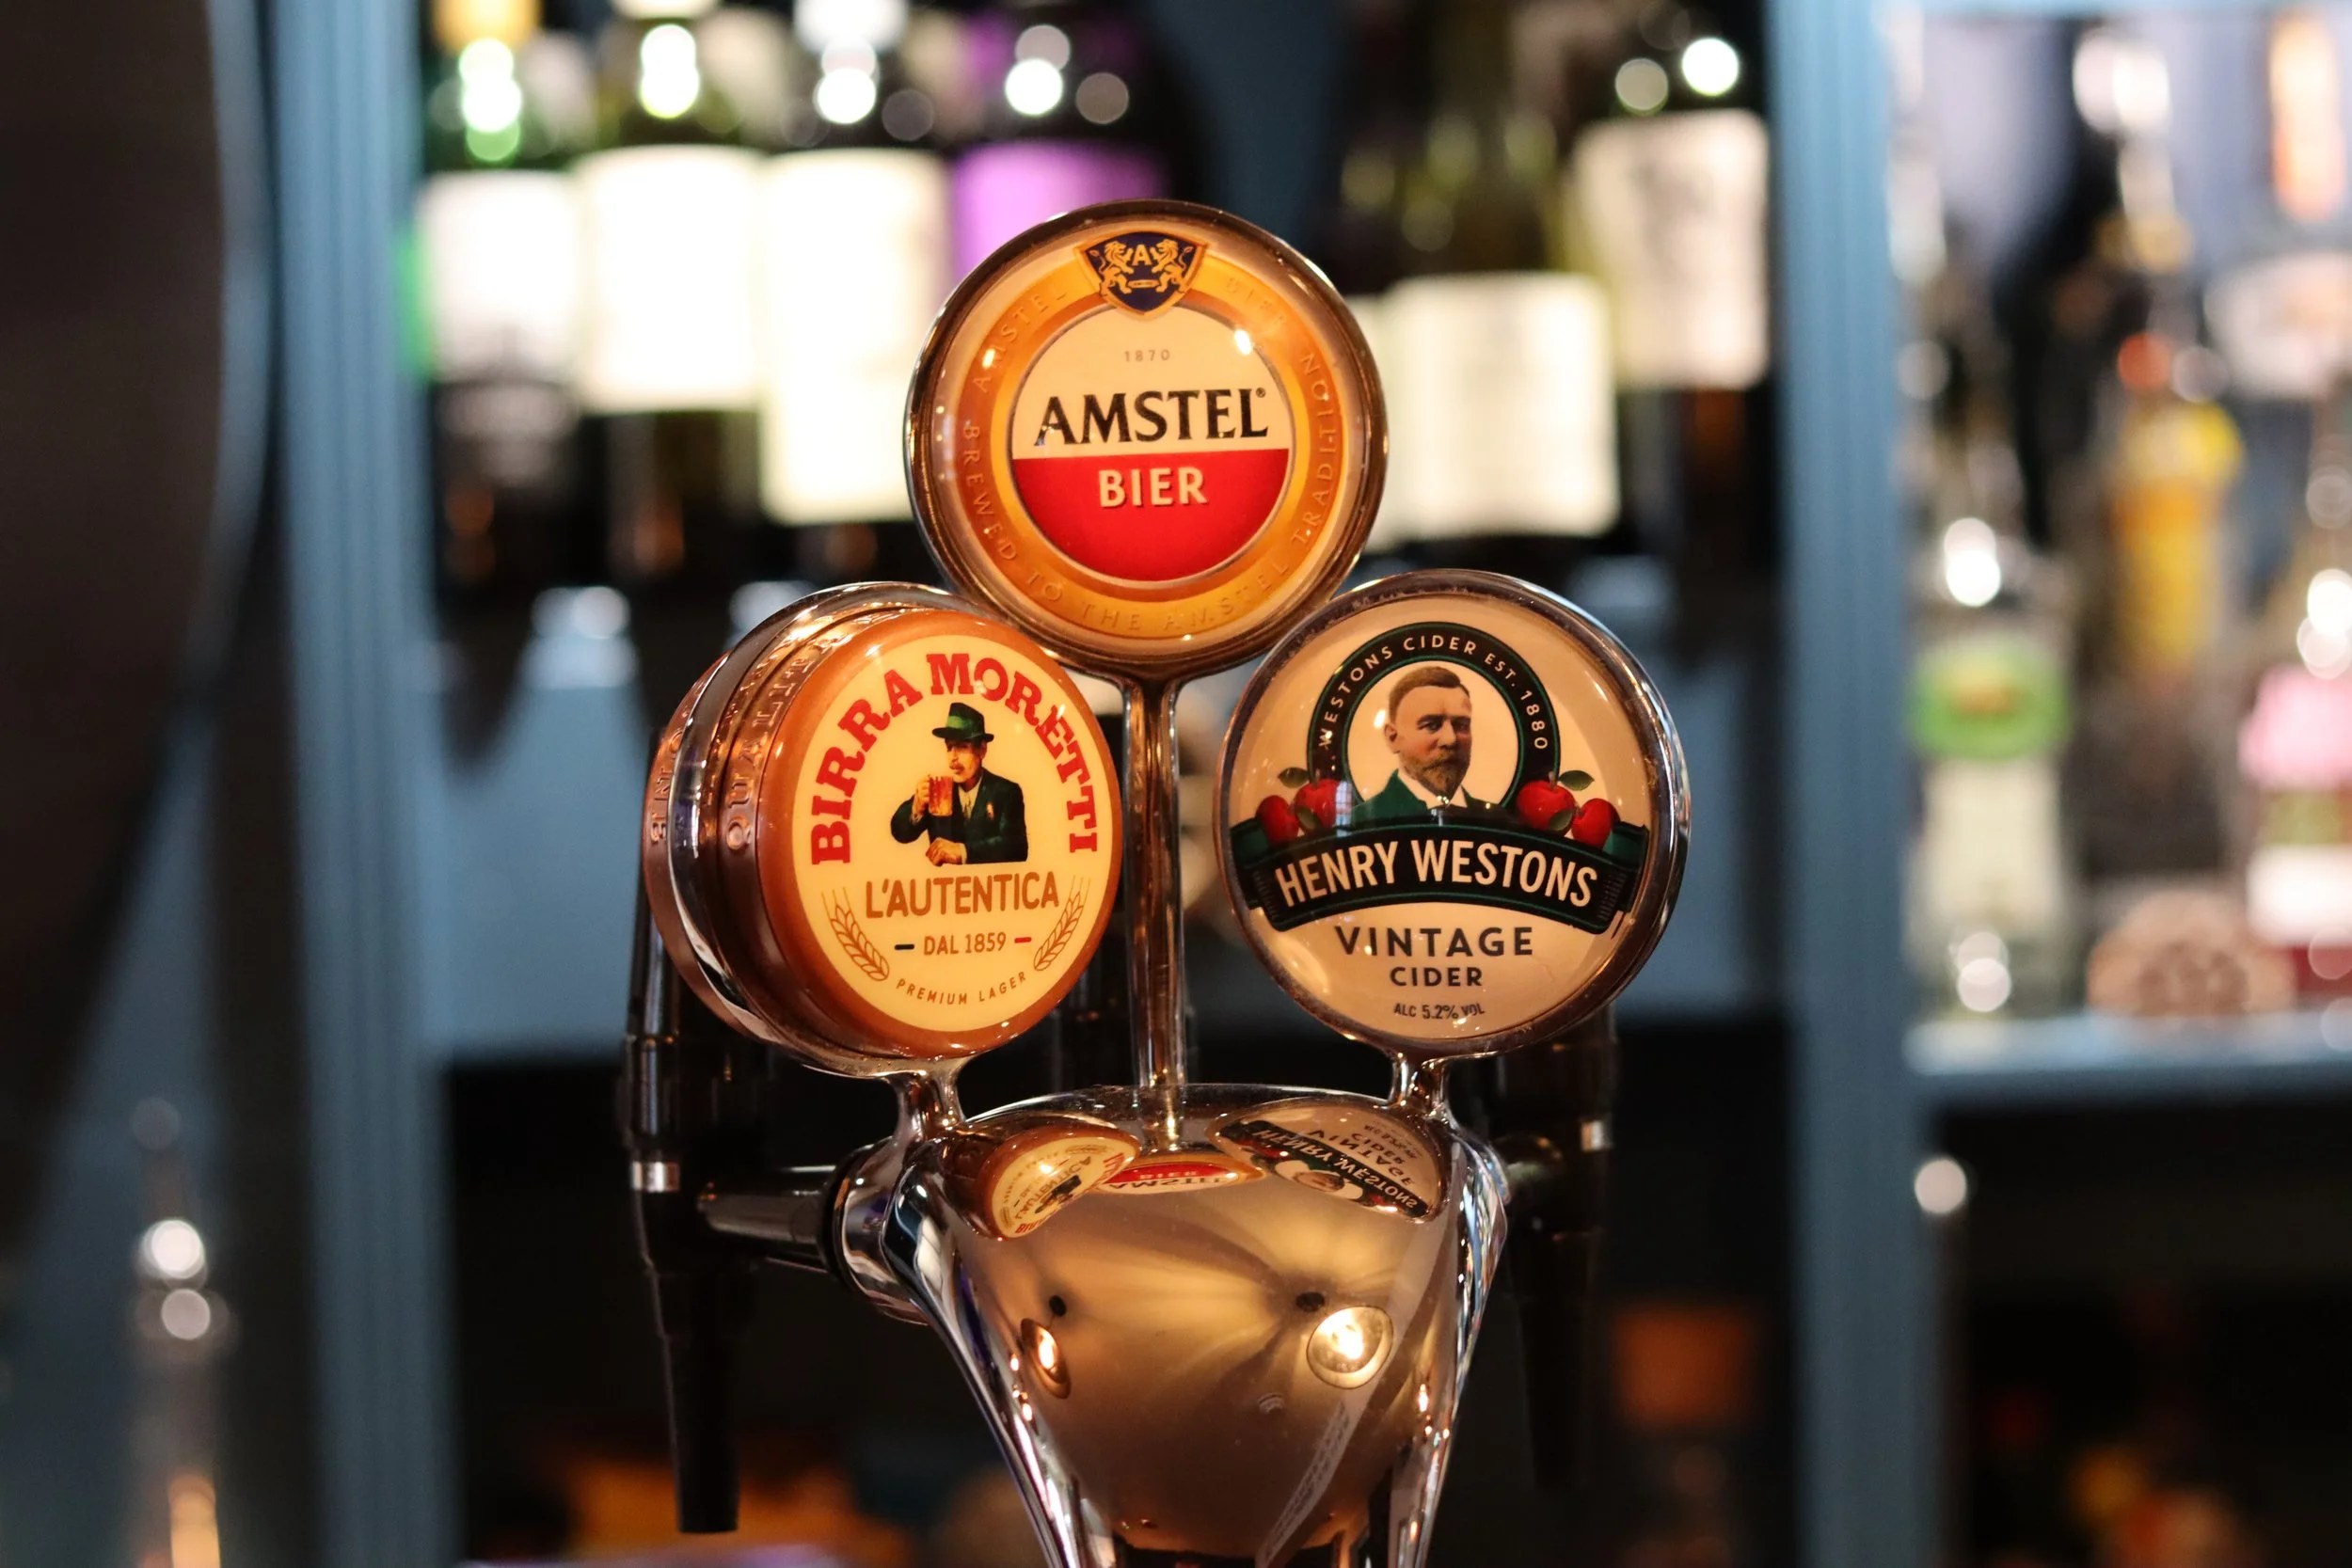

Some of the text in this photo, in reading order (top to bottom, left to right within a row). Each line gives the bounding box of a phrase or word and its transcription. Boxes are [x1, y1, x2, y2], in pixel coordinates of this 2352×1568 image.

[1132, 244, 1152, 266] A
[1124, 349, 1170, 363] 1870
[963, 424, 1018, 561] BREWED
[1027, 572, 1063, 602] TO
[1082, 603, 1139, 630] THE
[1291, 354, 1337, 546] TRADITION
[1098, 466, 1208, 508] BIER
[1319, 634, 1549, 750] WESTONS CIDER EST. 1880
[811, 669, 924, 864] BIRRA
[926, 653, 1098, 853] MORETTI
[1274, 839, 1597, 908] HENRY WESTONS
[866, 871, 1059, 919] L'AUTENTICA
[923, 931, 1007, 956] DAL 1859
[1334, 926, 1534, 958] VINTAGE
[895, 971, 1027, 1006] PREMIUM LAGER
[1390, 966, 1484, 988] CIDER
[1393, 1003, 1486, 1020] ALC 5.2% VOL
